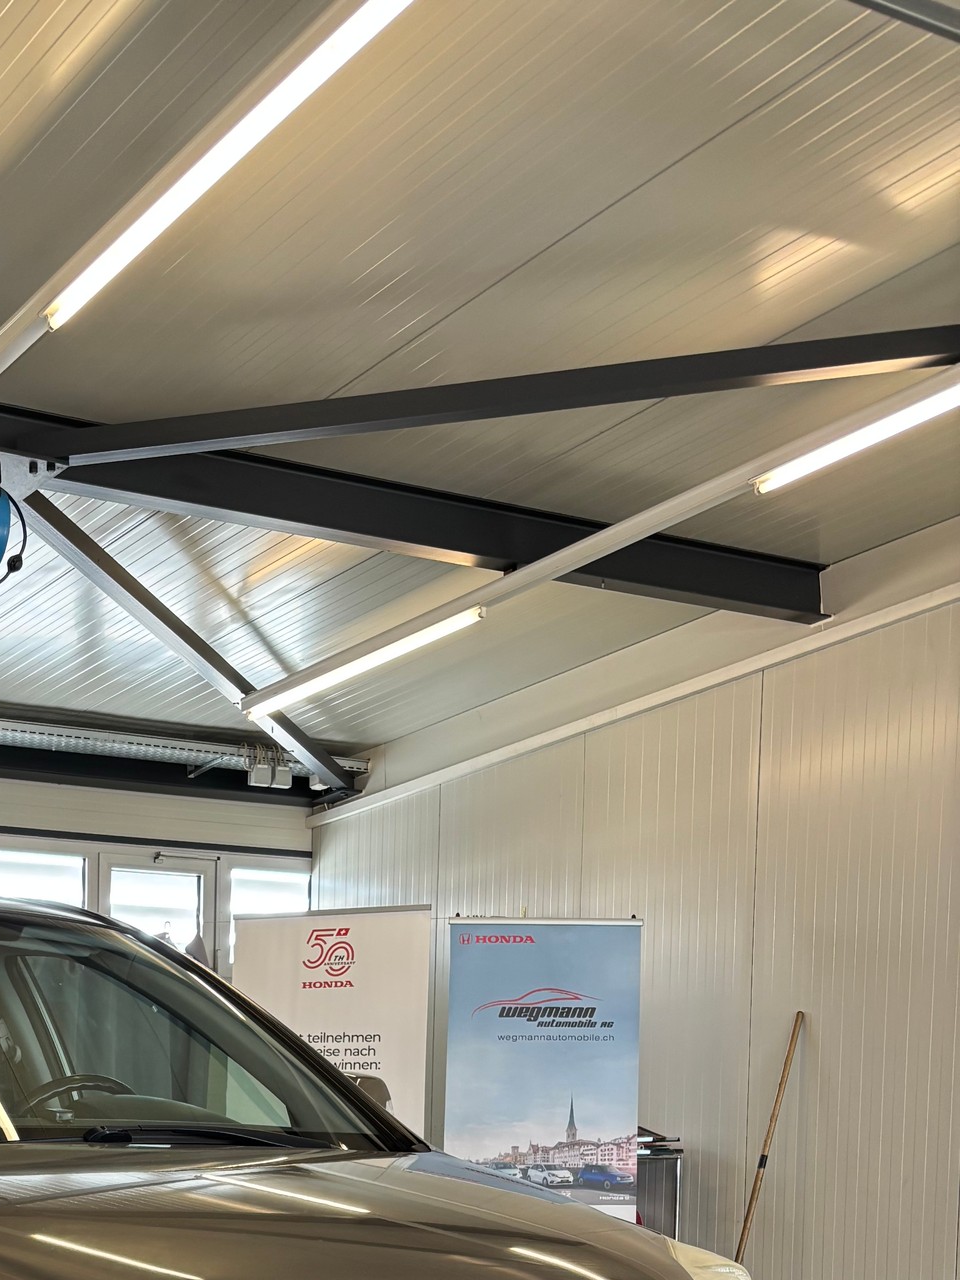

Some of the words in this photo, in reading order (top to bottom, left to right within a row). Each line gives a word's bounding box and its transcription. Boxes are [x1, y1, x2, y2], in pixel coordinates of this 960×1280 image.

[475, 935, 536, 944] HONDA
[302, 980, 355, 989] HONDA
[498, 1006, 597, 1022] wegmann
[307, 1032, 381, 1044] teilnehmen
[497, 1034, 615, 1043] wegmannautomobile.ch
[316, 1045, 340, 1057] eise
[344, 1045, 376, 1057] nach
